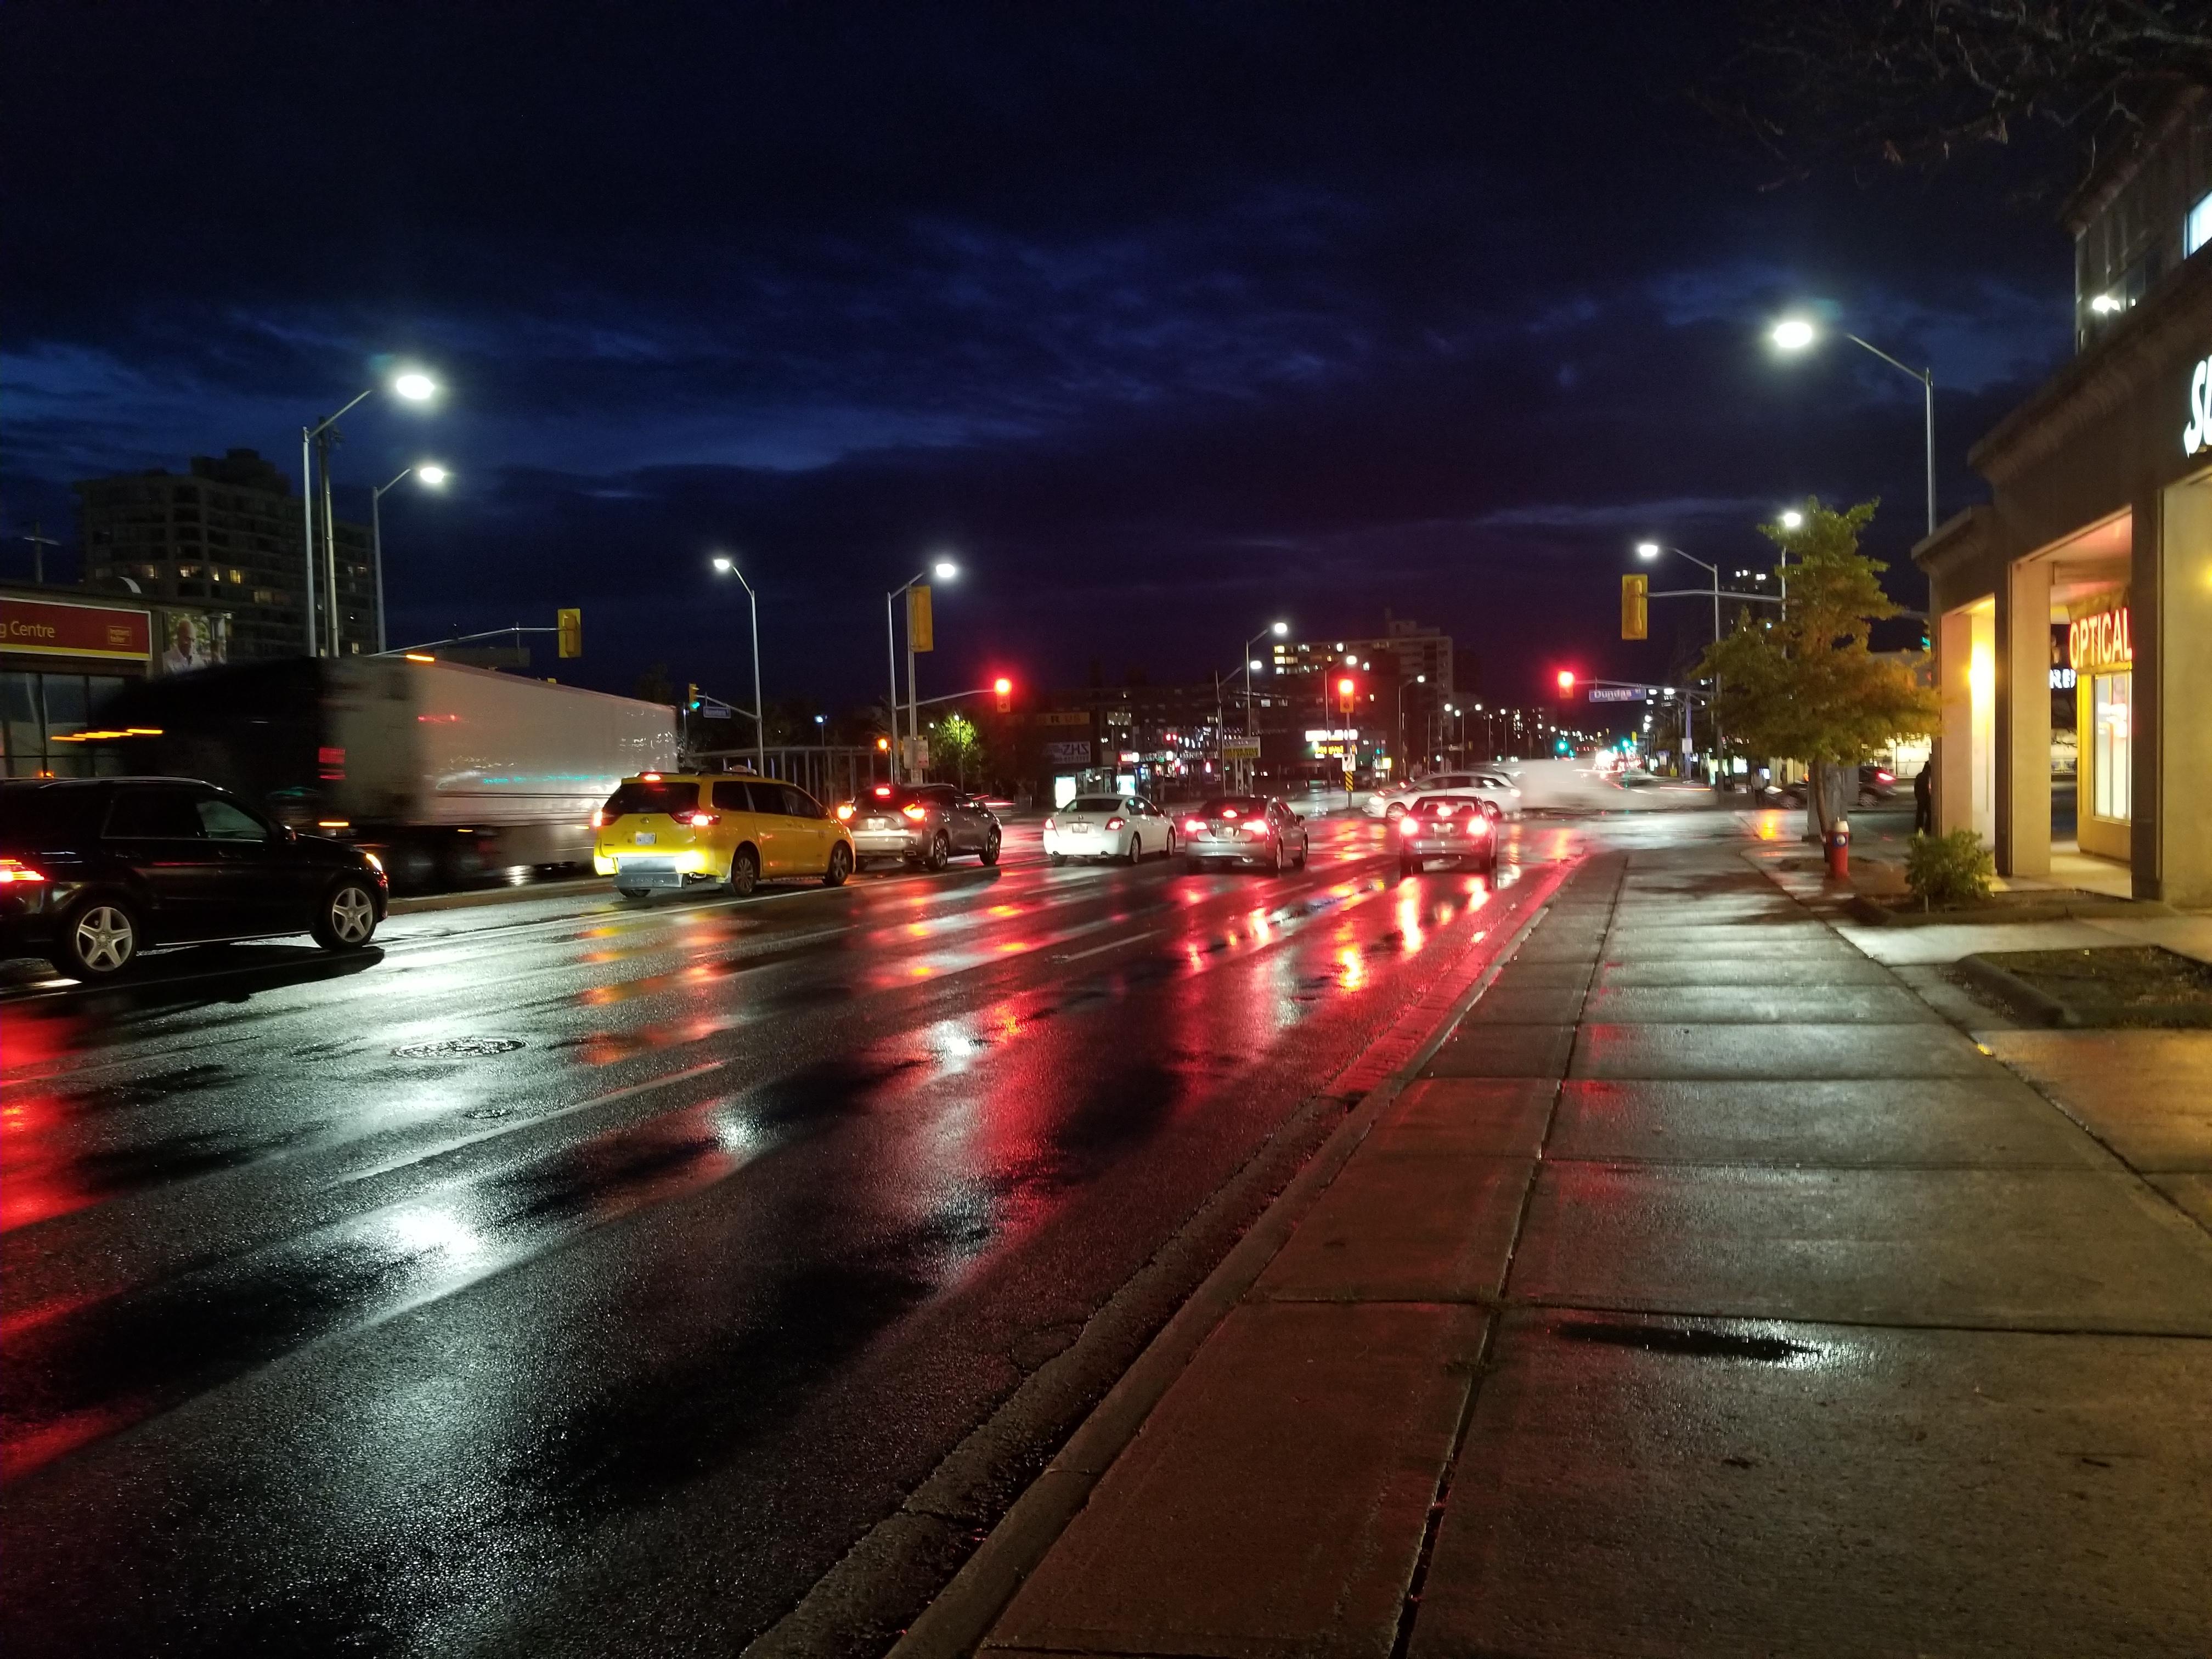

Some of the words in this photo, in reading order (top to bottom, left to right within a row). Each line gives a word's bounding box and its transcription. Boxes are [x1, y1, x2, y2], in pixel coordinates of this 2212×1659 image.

[11, 620, 55, 638] Centre
[2069, 608, 2132, 669] OPTICAL
[1594, 689, 1632, 699] Dundas
